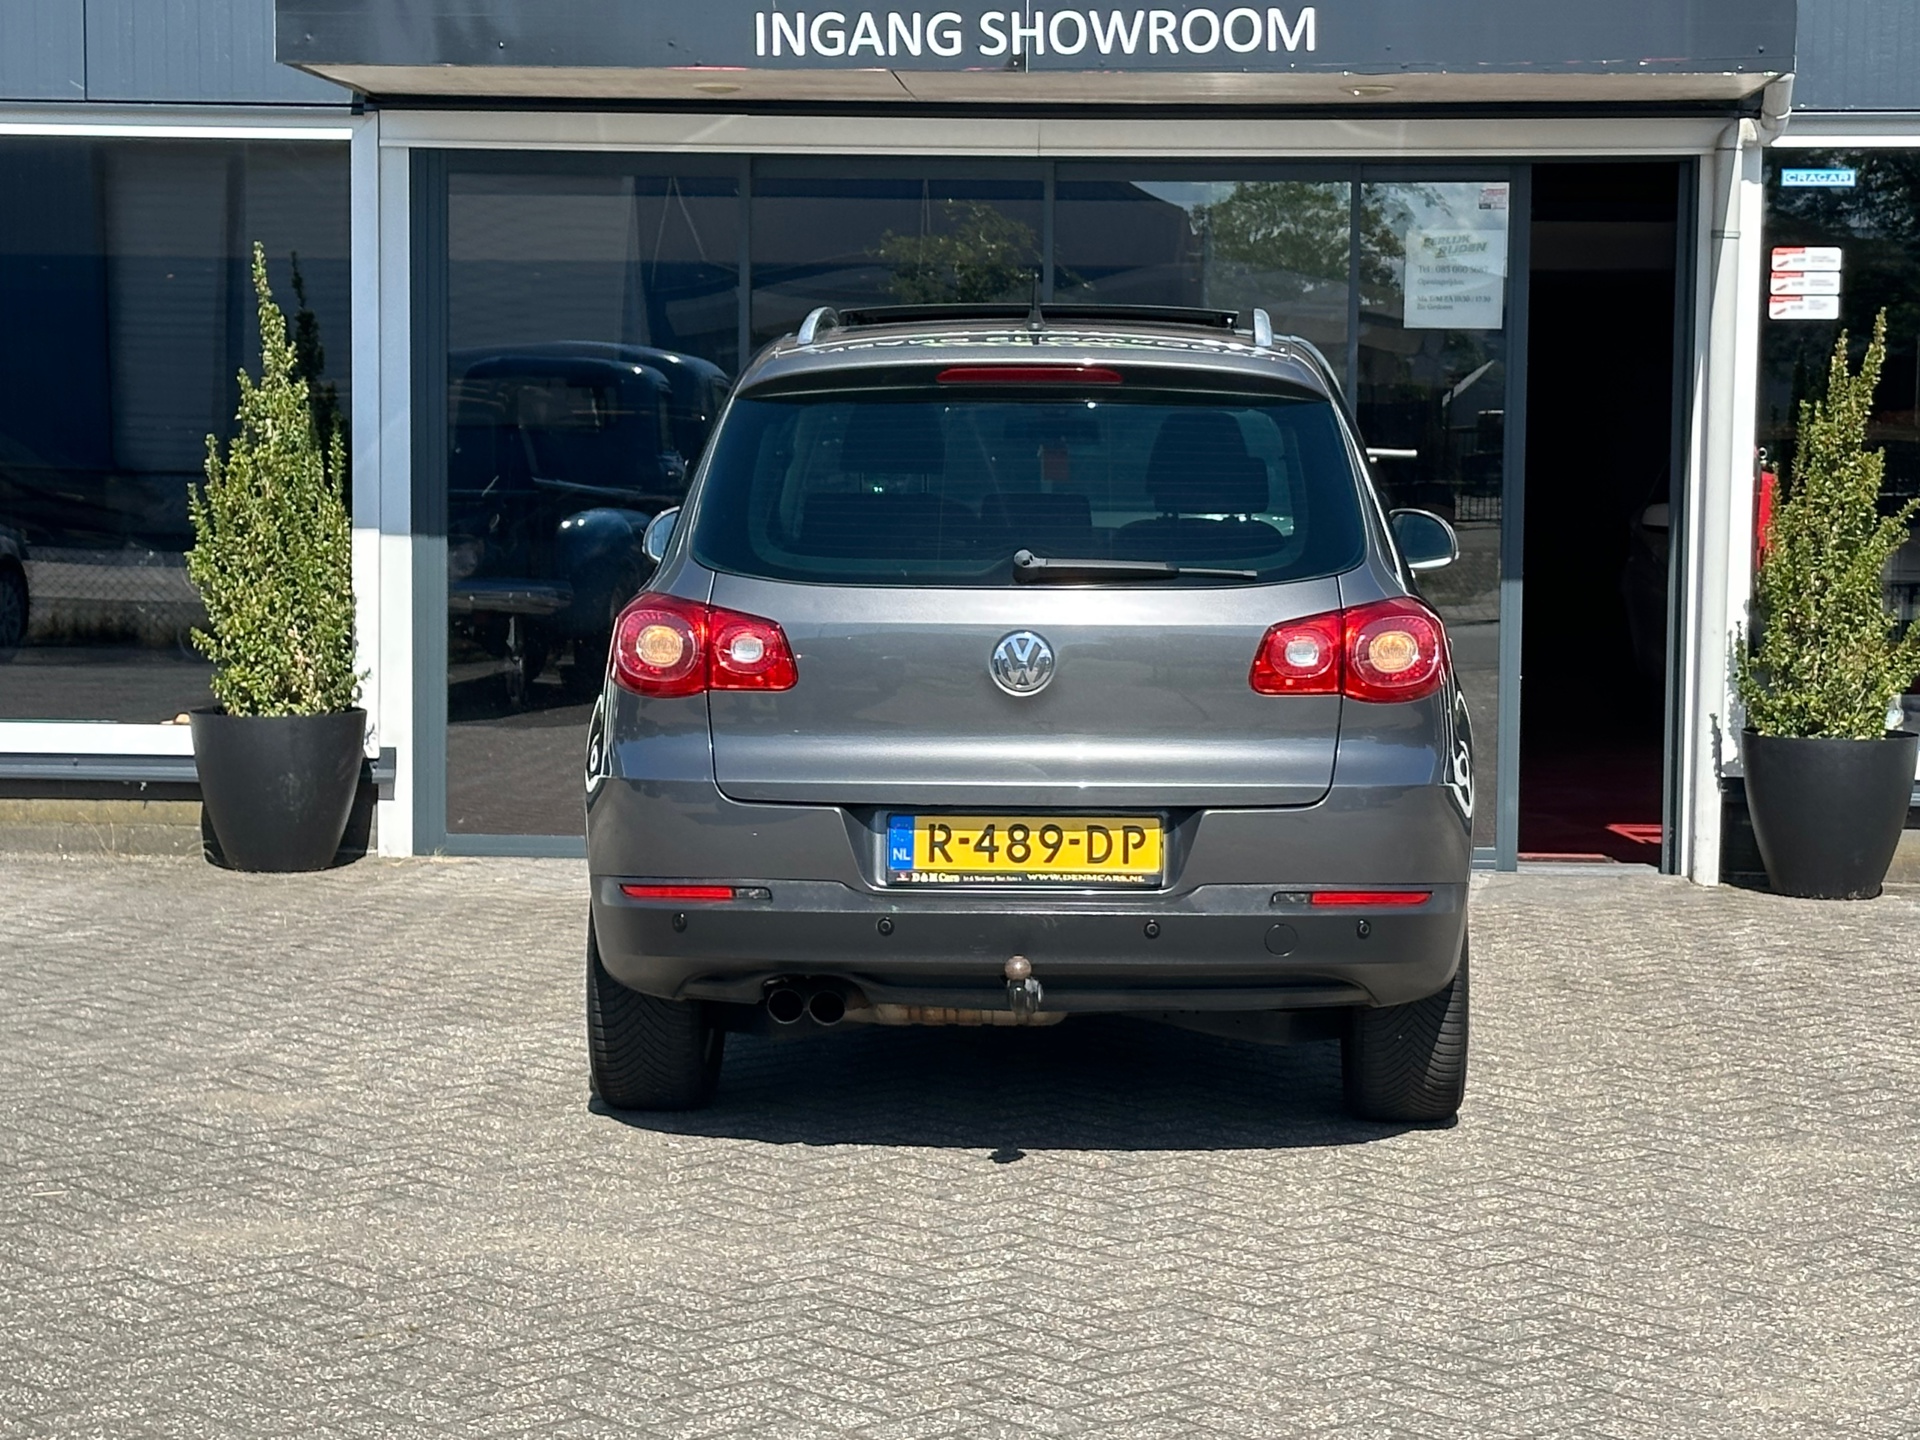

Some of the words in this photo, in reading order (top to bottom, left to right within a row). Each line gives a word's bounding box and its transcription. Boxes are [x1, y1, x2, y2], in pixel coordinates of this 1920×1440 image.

[755, 11, 963, 58] INGANG
[979, 6, 1317, 56] SHOWROOM
[1785, 173, 1852, 183] CRAGAR
[1435, 242, 1488, 258] RIJDEN
[928, 823, 1147, 864] R-489-DP
[892, 847, 911, 861] NL
